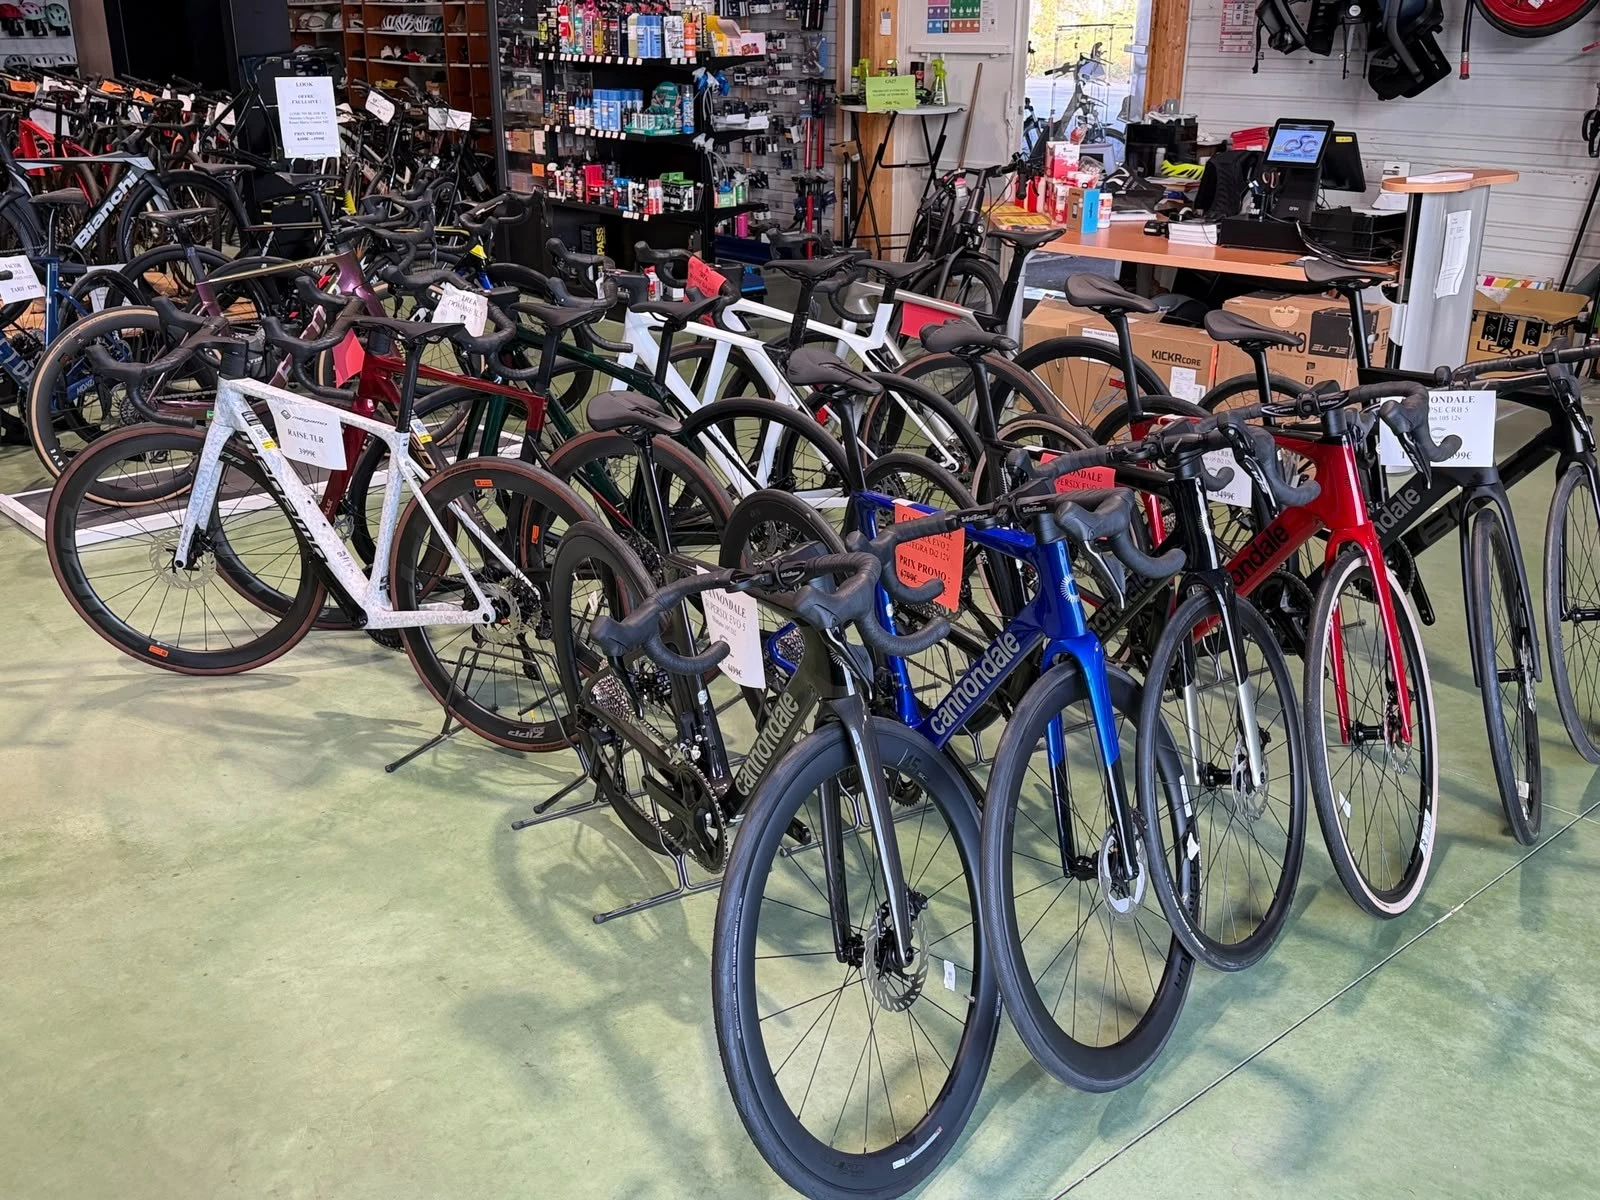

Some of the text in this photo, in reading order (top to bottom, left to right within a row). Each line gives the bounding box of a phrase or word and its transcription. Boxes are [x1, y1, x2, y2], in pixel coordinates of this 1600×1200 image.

[74, 170, 138, 250] Bianchi
[1151, 349, 1202, 367] KICKR CORE
[1430, 395, 1475, 404] ONDALE
[287, 428, 309, 441] RAISE
[310, 434, 325, 444] TLR
[298, 448, 317, 459] 3999€
[1069, 470, 1103, 482] ONDALE
[932, 538, 947, 550] EVO
[1230, 526, 1289, 586] ondale
[899, 555, 916, 571] PRIX
[917, 561, 947, 580] PROMO
[930, 632, 1020, 735] cannondale
[735, 692, 799, 796] cannondale
